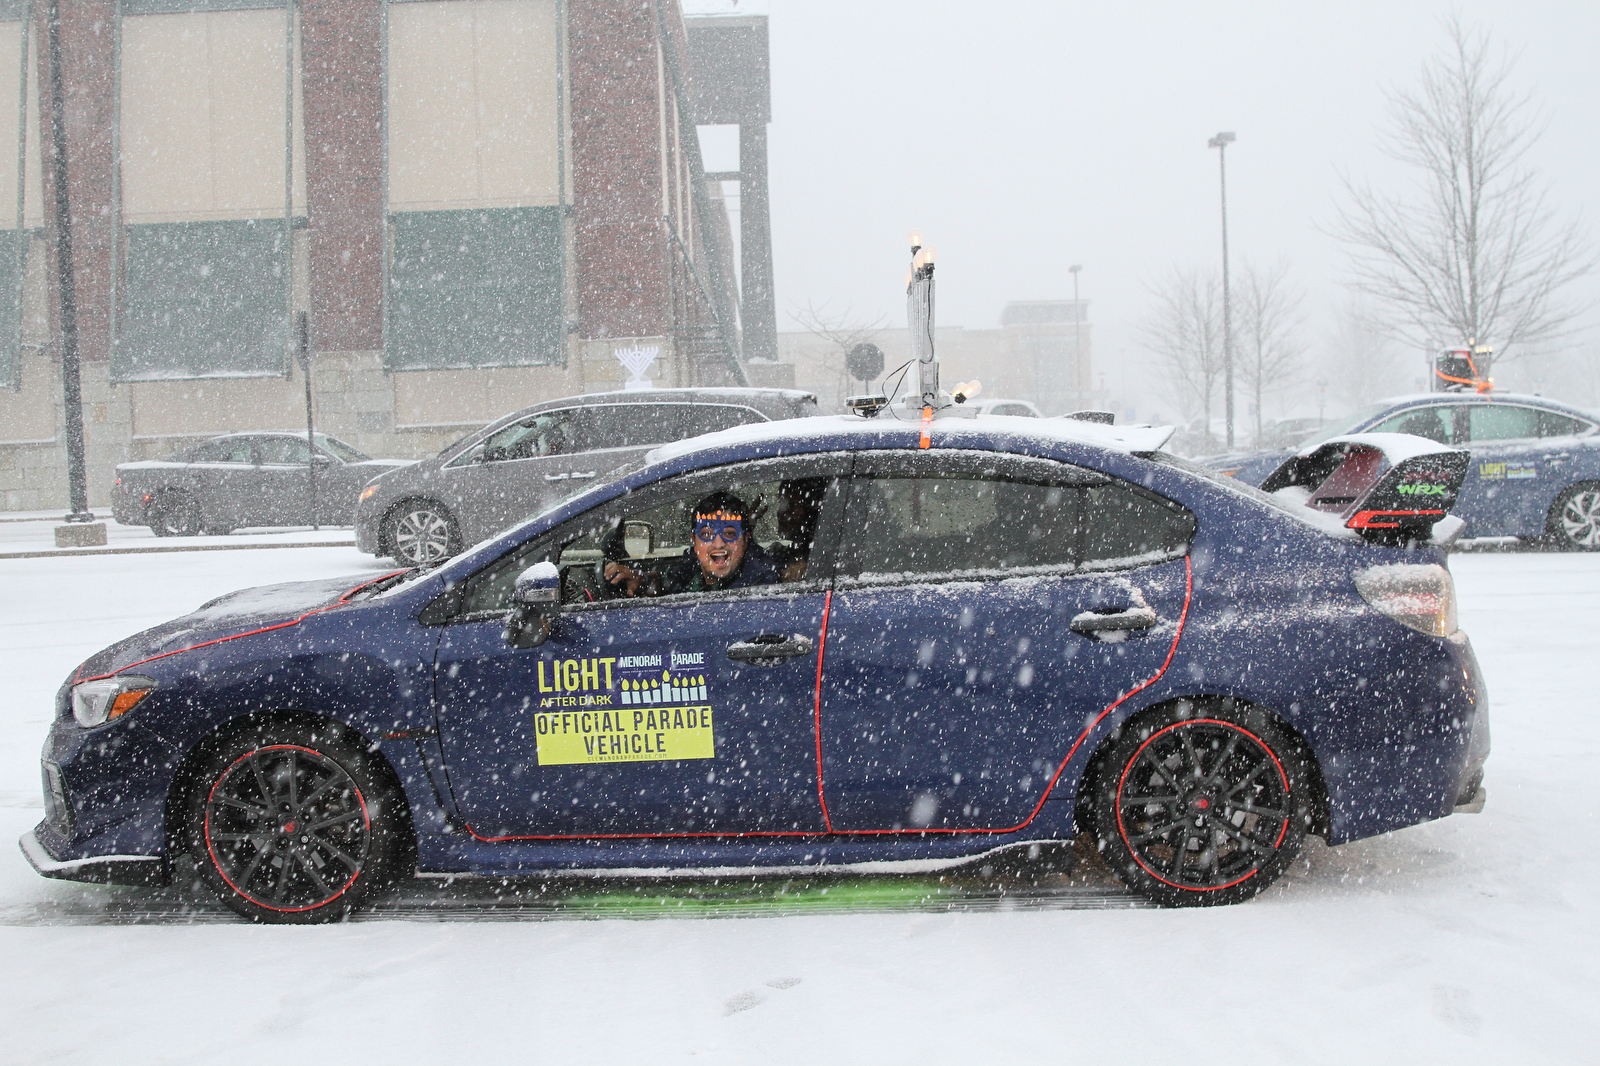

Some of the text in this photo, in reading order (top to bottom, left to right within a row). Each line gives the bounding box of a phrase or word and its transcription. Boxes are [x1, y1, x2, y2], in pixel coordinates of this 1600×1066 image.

[1480, 462, 1506, 475] LIGHT
[1398, 484, 1447, 495] WRX
[620, 652, 705, 668] MENORAH PARADE
[537, 657, 616, 692] LIGHT
[539, 694, 613, 708] AFTER DARK
[538, 708, 710, 735] OFFICIAL PARADE
[584, 733, 666, 755] VEHICLE
